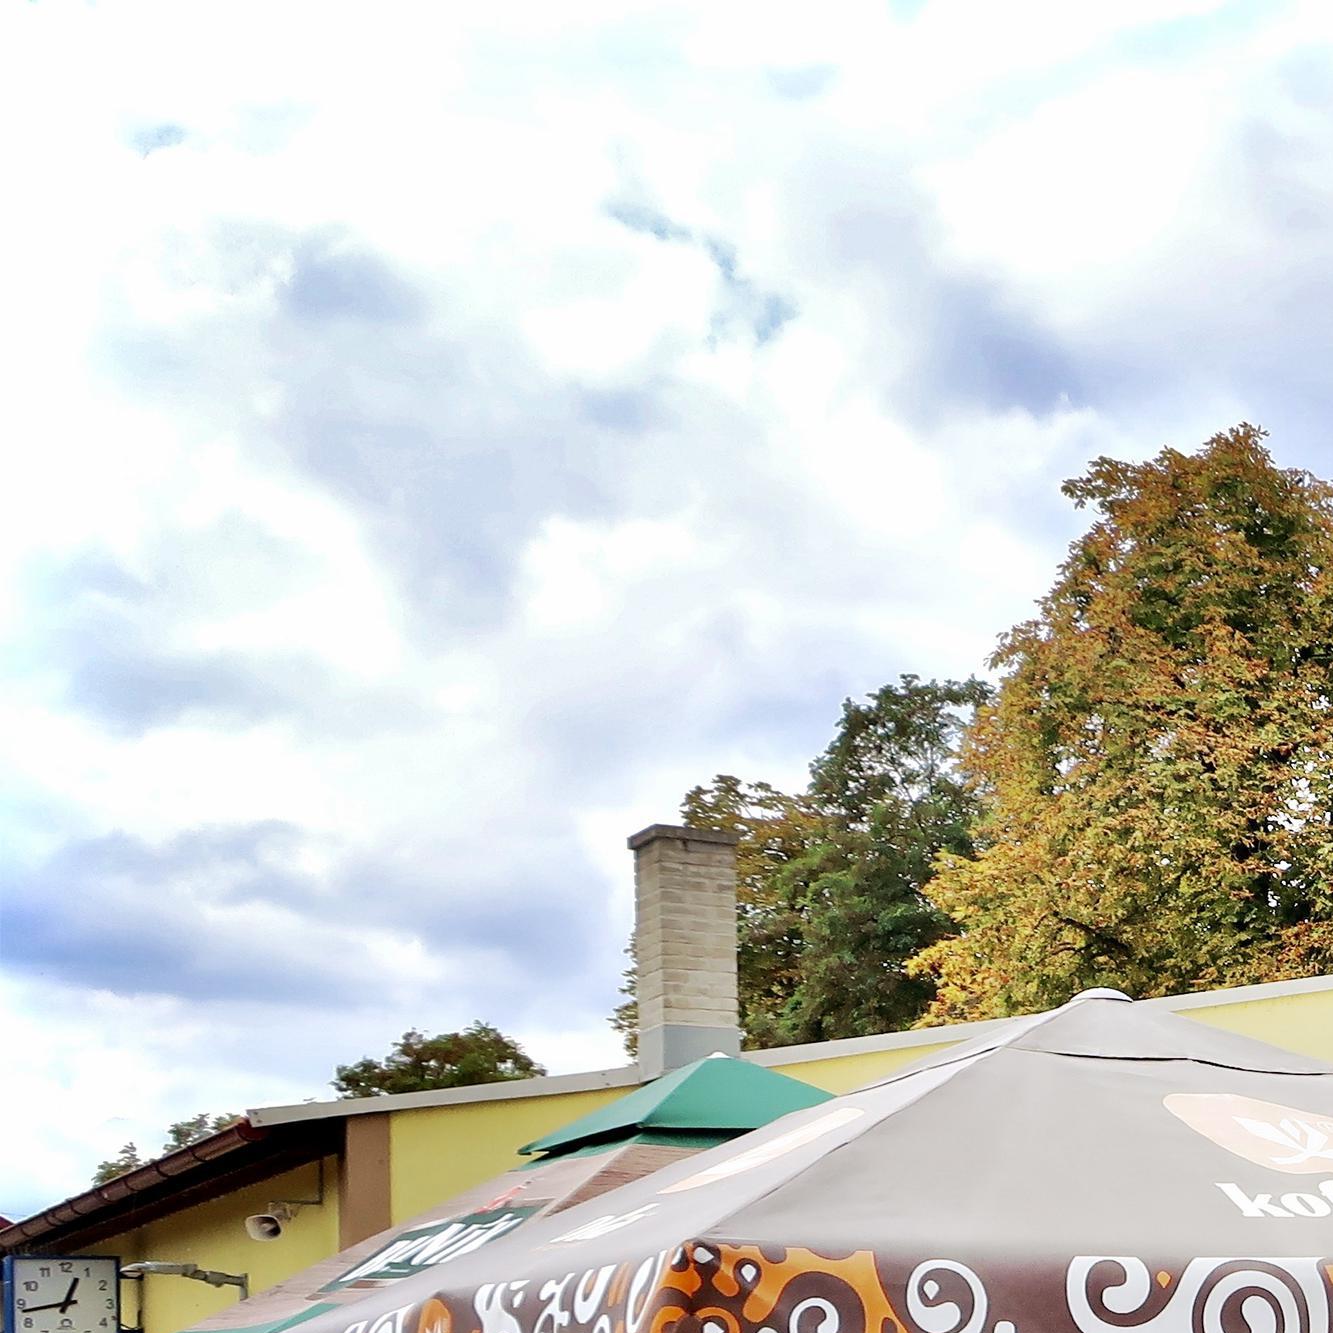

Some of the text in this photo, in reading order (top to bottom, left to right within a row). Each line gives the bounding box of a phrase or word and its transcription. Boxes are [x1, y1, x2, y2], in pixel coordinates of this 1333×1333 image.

[40, 1267, 51, 1277] 11
[59, 1262, 73, 1273] 12
[84, 1267, 91, 1277] 1
[23, 1280, 39, 1292] 10
[98, 1280, 107, 1291] 2
[17, 1298, 26, 1309] 9
[106, 1299, 115, 1309] 3
[24, 1318, 33, 1328] 8
[99, 1318, 108, 1327] 4
